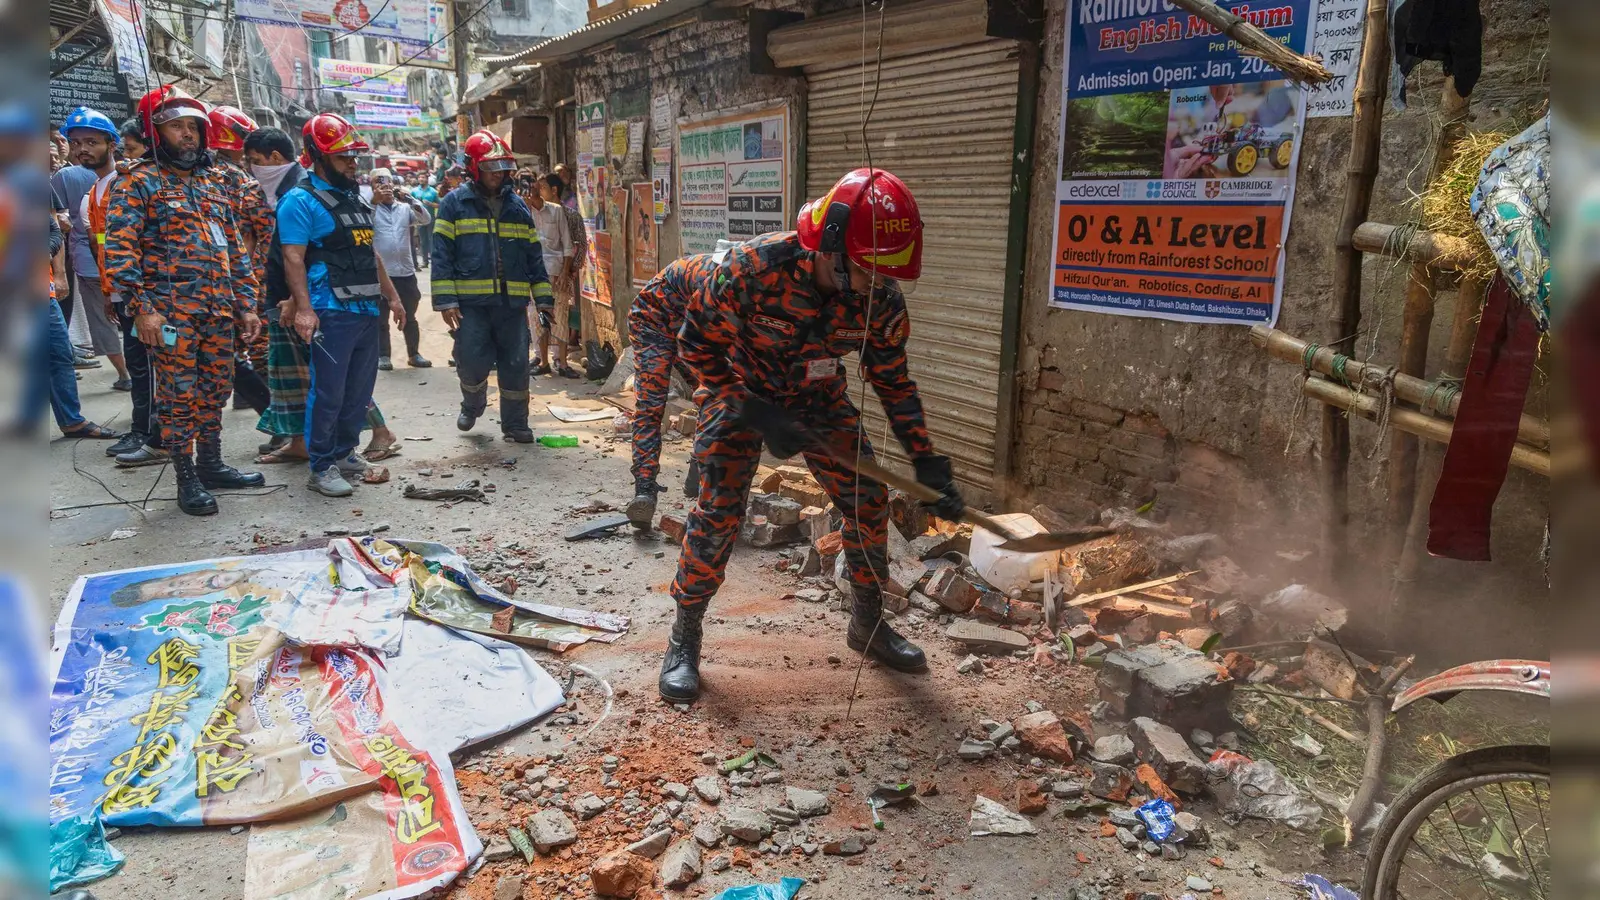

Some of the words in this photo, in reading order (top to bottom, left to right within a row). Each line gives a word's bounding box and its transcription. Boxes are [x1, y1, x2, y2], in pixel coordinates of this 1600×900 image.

[1336, 8, 1358, 20] হবে
[1098, 16, 1183, 53] English
[1185, 5, 1294, 39] Meium
[1208, 40, 1225, 53] Pre
[1330, 48, 1354, 65] রুম
[1078, 69, 1149, 92] Admission
[1153, 65, 1197, 86] Open:
[1201, 60, 1236, 80] Jan,
[1240, 56, 1282, 75] 202
[1176, 94, 1207, 103] Robotics
[1070, 183, 1120, 197] edexcel
[1164, 181, 1196, 190] BRITISH
[1221, 181, 1272, 190] CAMBRIDGE
[1162, 190, 1197, 198] COUNCIL
[1068, 214, 1095, 243] O'
[1101, 215, 1123, 245] &
[1130, 216, 1163, 245] A'
[1168, 216, 1267, 249] Level
[1063, 248, 1105, 265] directly
[1107, 250, 1136, 265] from
[1139, 252, 1211, 269] Rainforest
[1213, 256, 1269, 273] School
[1063, 273, 1090, 285] Hifzul
[1138, 279, 1192, 295] Robotics,
[1194, 282, 1243, 300] Coding,
[1246, 286, 1262, 298] AI
[1092, 294, 1107, 302] Ghosh
[1108, 295, 1121, 304] Road,
[1156, 300, 1175, 309] Umesh
[1175, 301, 1189, 310] Dutta
[1190, 302, 1206, 312] Road,
[1207, 304, 1245, 316] Bakshibazar,
[1246, 307, 1266, 317] Dhaka
